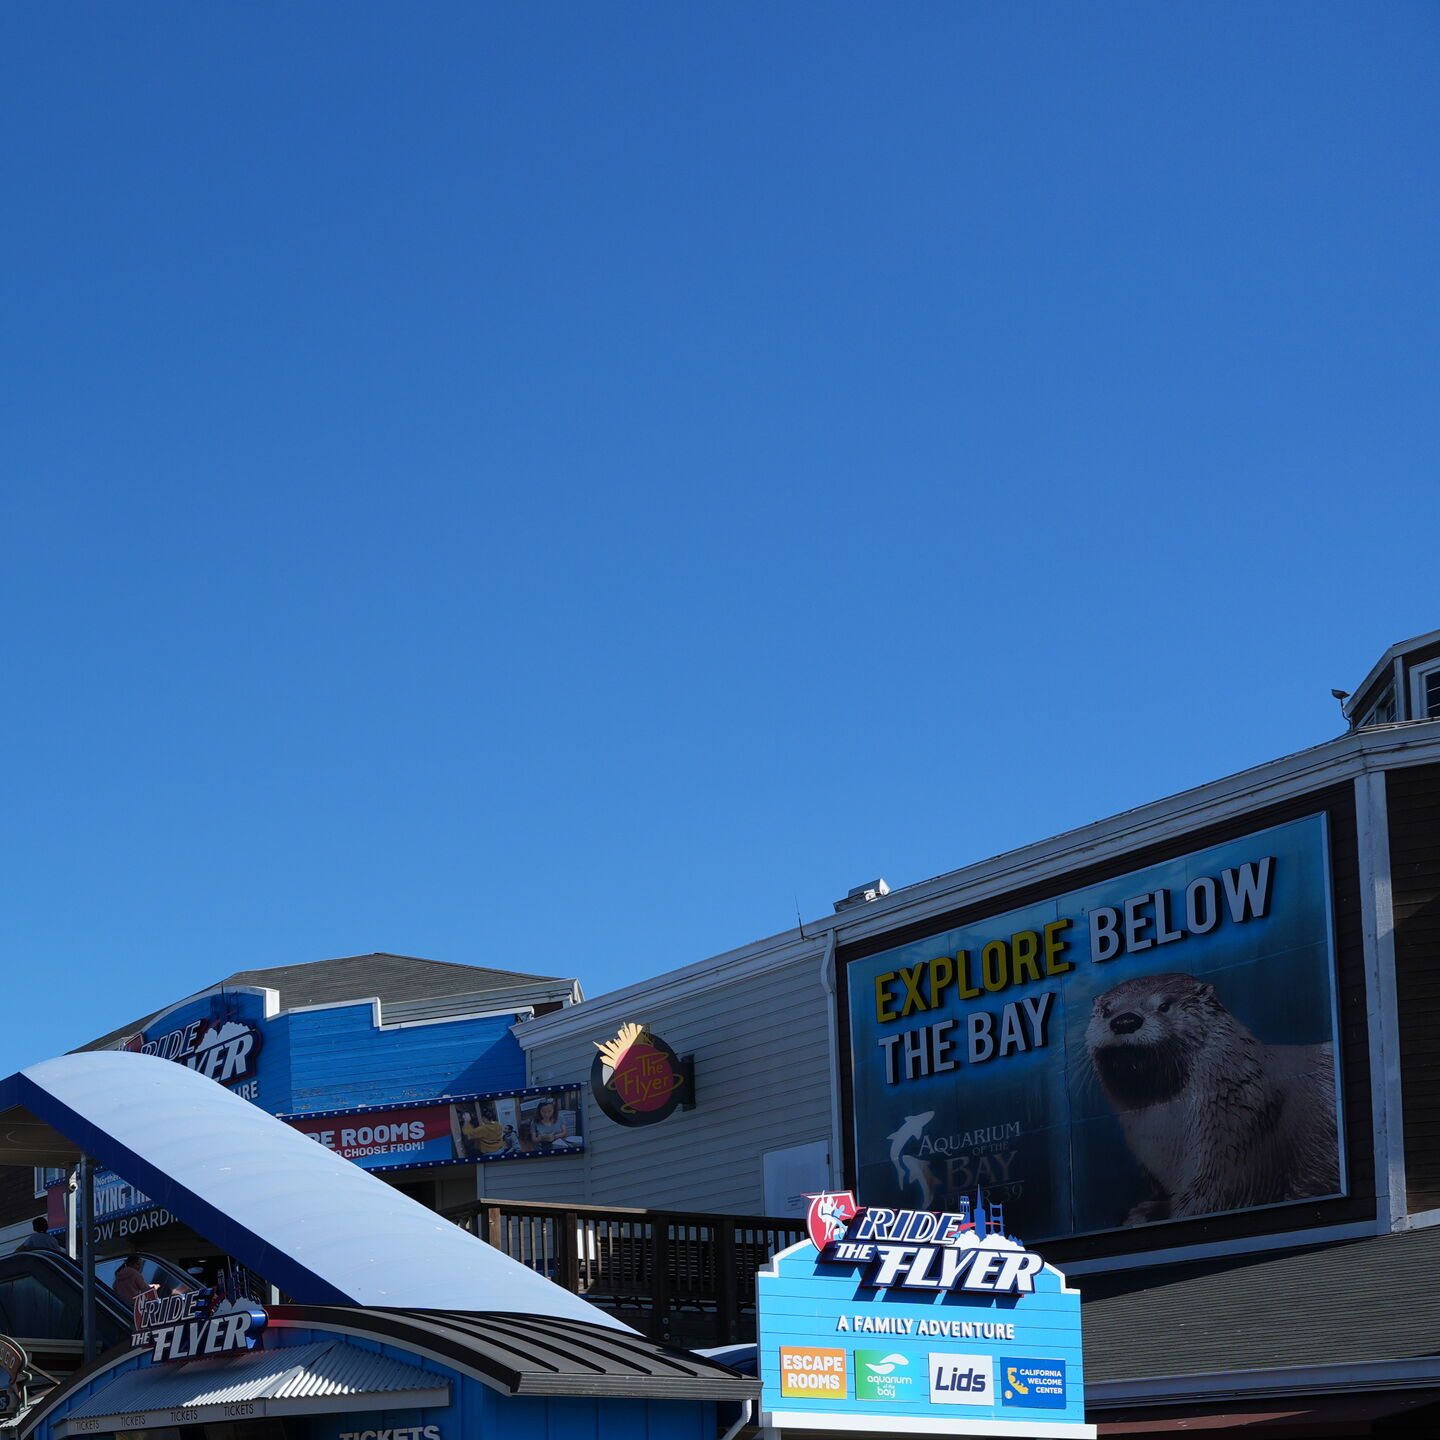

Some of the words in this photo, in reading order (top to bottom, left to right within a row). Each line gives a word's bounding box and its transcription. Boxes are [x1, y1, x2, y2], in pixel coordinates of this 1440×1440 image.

[874, 918, 1076, 1024] EXPLORE
[1088, 856, 1278, 963] BELOW
[877, 1019, 958, 1085] THE
[966, 992, 1057, 1064] BAY
[635, 1052, 669, 1077] The
[613, 1067, 669, 1102] Flyer
[340, 1121, 425, 1147] ROOMS
[918, 1121, 1021, 1156] AQUARIUM
[344, 1144, 389, 1158] CHOOSE
[390, 1140, 425, 1153] FROM!
[943, 1150, 1019, 1191] BAY
[856, 1208, 965, 1245] RIDE
[833, 1243, 873, 1261] THE
[872, 1244, 1045, 1292] FLYER
[141, 1288, 202, 1328] RIDE
[131, 1331, 151, 1347] THE
[151, 1312, 252, 1362] FLYER
[836, 1315, 849, 1331] A
[853, 1316, 914, 1335] FAMILY
[917, 1319, 1016, 1340] ADVENTURE
[783, 1355, 843, 1372] ESCAPE
[1020, 1368, 1062, 1377] CALIFORNIA
[787, 1373, 840, 1390] ROOMS
[866, 1374, 912, 1387] aquarium
[935, 1366, 986, 1393] Lids
[1027, 1377, 1063, 1386] WELCOME
[1035, 1386, 1063, 1394] CENTER
[877, 1386, 896, 1399] bay
[121, 1414, 146, 1426] TICKETS
[170, 1409, 198, 1422] TICKETS
[224, 1403, 254, 1417] TICKETS
[76, 1419, 100, 1431] TICKETS
